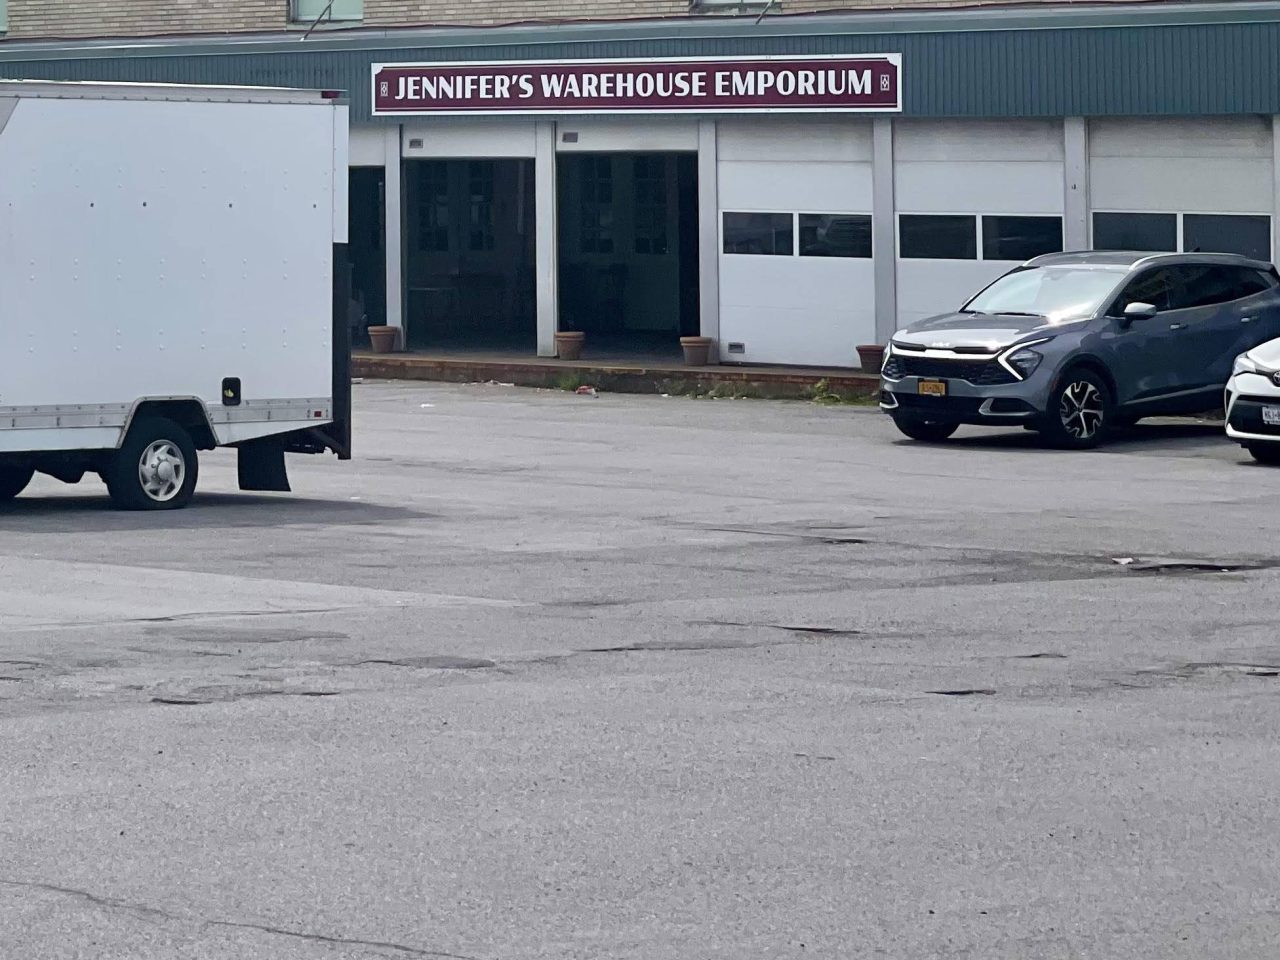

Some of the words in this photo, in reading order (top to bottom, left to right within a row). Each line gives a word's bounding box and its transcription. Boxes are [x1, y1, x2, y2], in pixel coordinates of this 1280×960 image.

[394, 73, 535, 100] JENNIFER'S
[540, 71, 708, 98] WAREHOUSE
[714, 69, 872, 96] EMPORIUM
